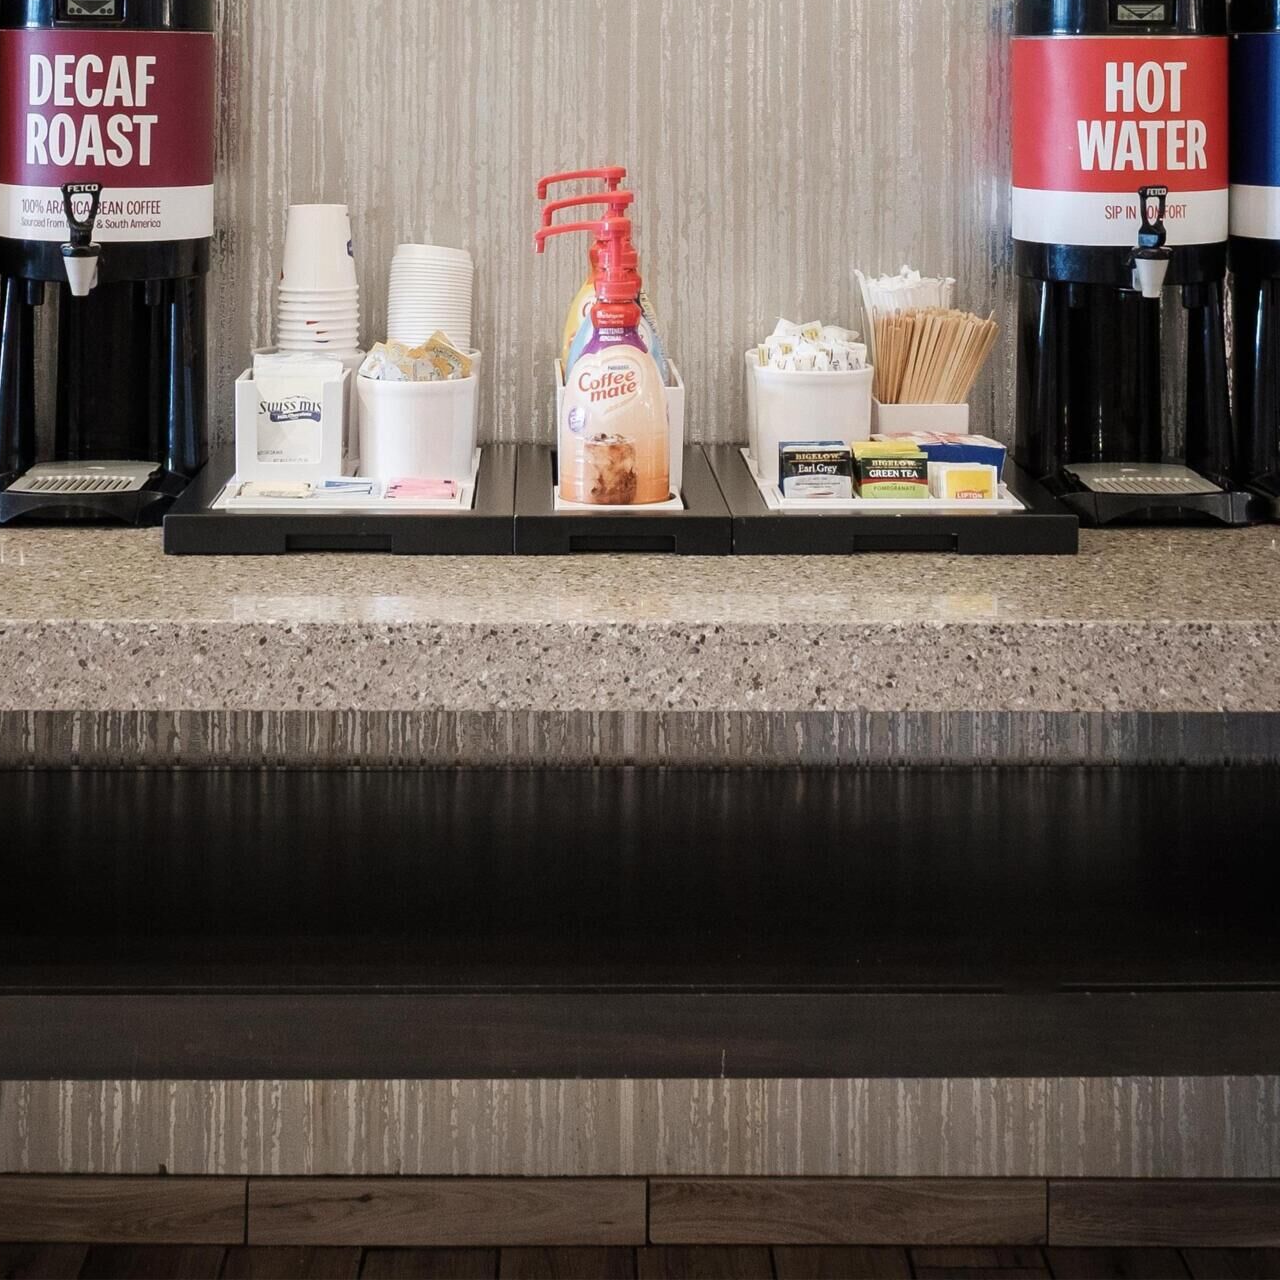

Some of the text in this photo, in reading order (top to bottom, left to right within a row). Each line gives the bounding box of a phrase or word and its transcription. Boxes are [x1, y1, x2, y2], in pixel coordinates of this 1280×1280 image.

[29, 54, 157, 107] DECAF
[1105, 61, 1188, 113] HOT
[26, 113, 158, 167] ROAST
[1077, 119, 1208, 171] WATER
[67, 184, 99, 192] FETCO
[1146, 188, 1167, 196] FETCO
[22, 199, 44, 214] 100%
[46, 200, 91, 215] ARAICA
[126, 200, 161, 215] COFFEE
[1105, 205, 1122, 220] SIP
[1125, 205, 1137, 220] IN
[96, 219, 103, 229] &
[105, 219, 129, 229] South
[131, 219, 161, 229] America
[579, 371, 636, 393] Coffee
[590, 381, 637, 402] mate
[795, 452, 839, 461] BIGELOW
[871, 459, 916, 467] BIGELOW
[798, 463, 837, 475] Earl Grey
[869, 469, 918, 478] GREEN TEA
